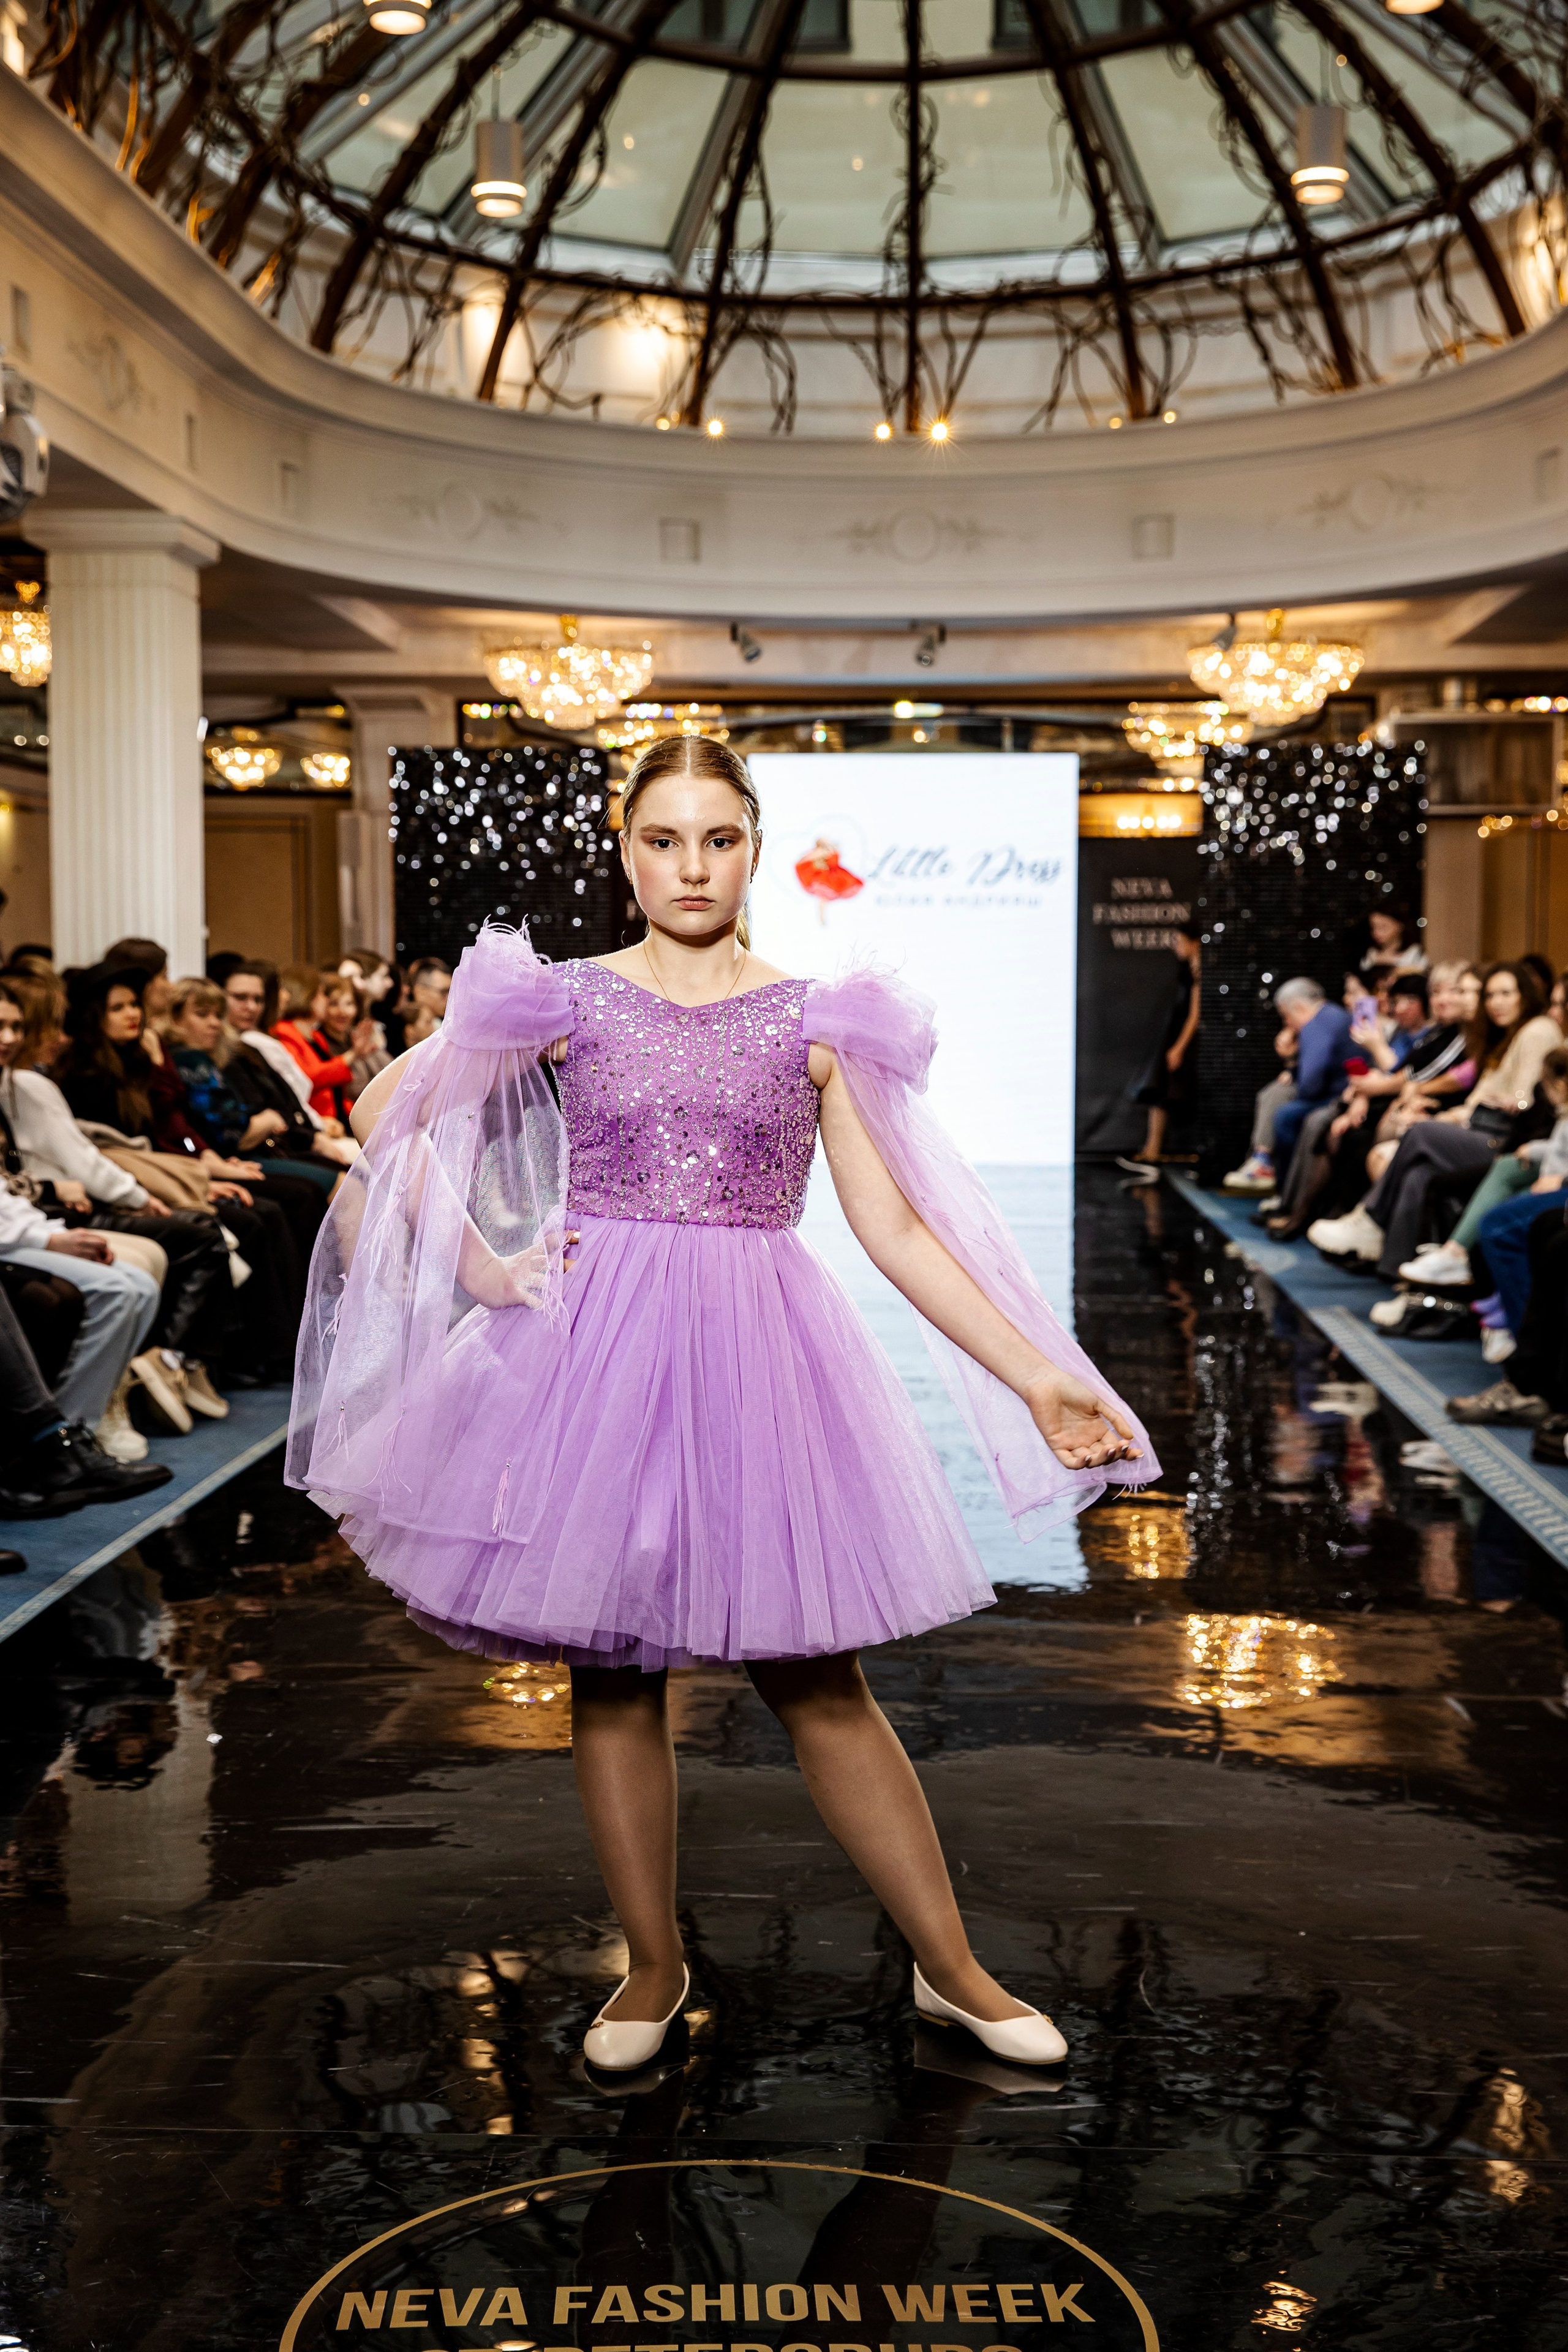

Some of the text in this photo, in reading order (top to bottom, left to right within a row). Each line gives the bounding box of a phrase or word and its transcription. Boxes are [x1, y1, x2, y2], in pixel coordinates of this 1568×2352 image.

[1111, 878, 1173, 899] NEVA
[1093, 902, 1191, 925] FASHION
[336, 2283, 1096, 2330] NEVA FASHION WEEK
